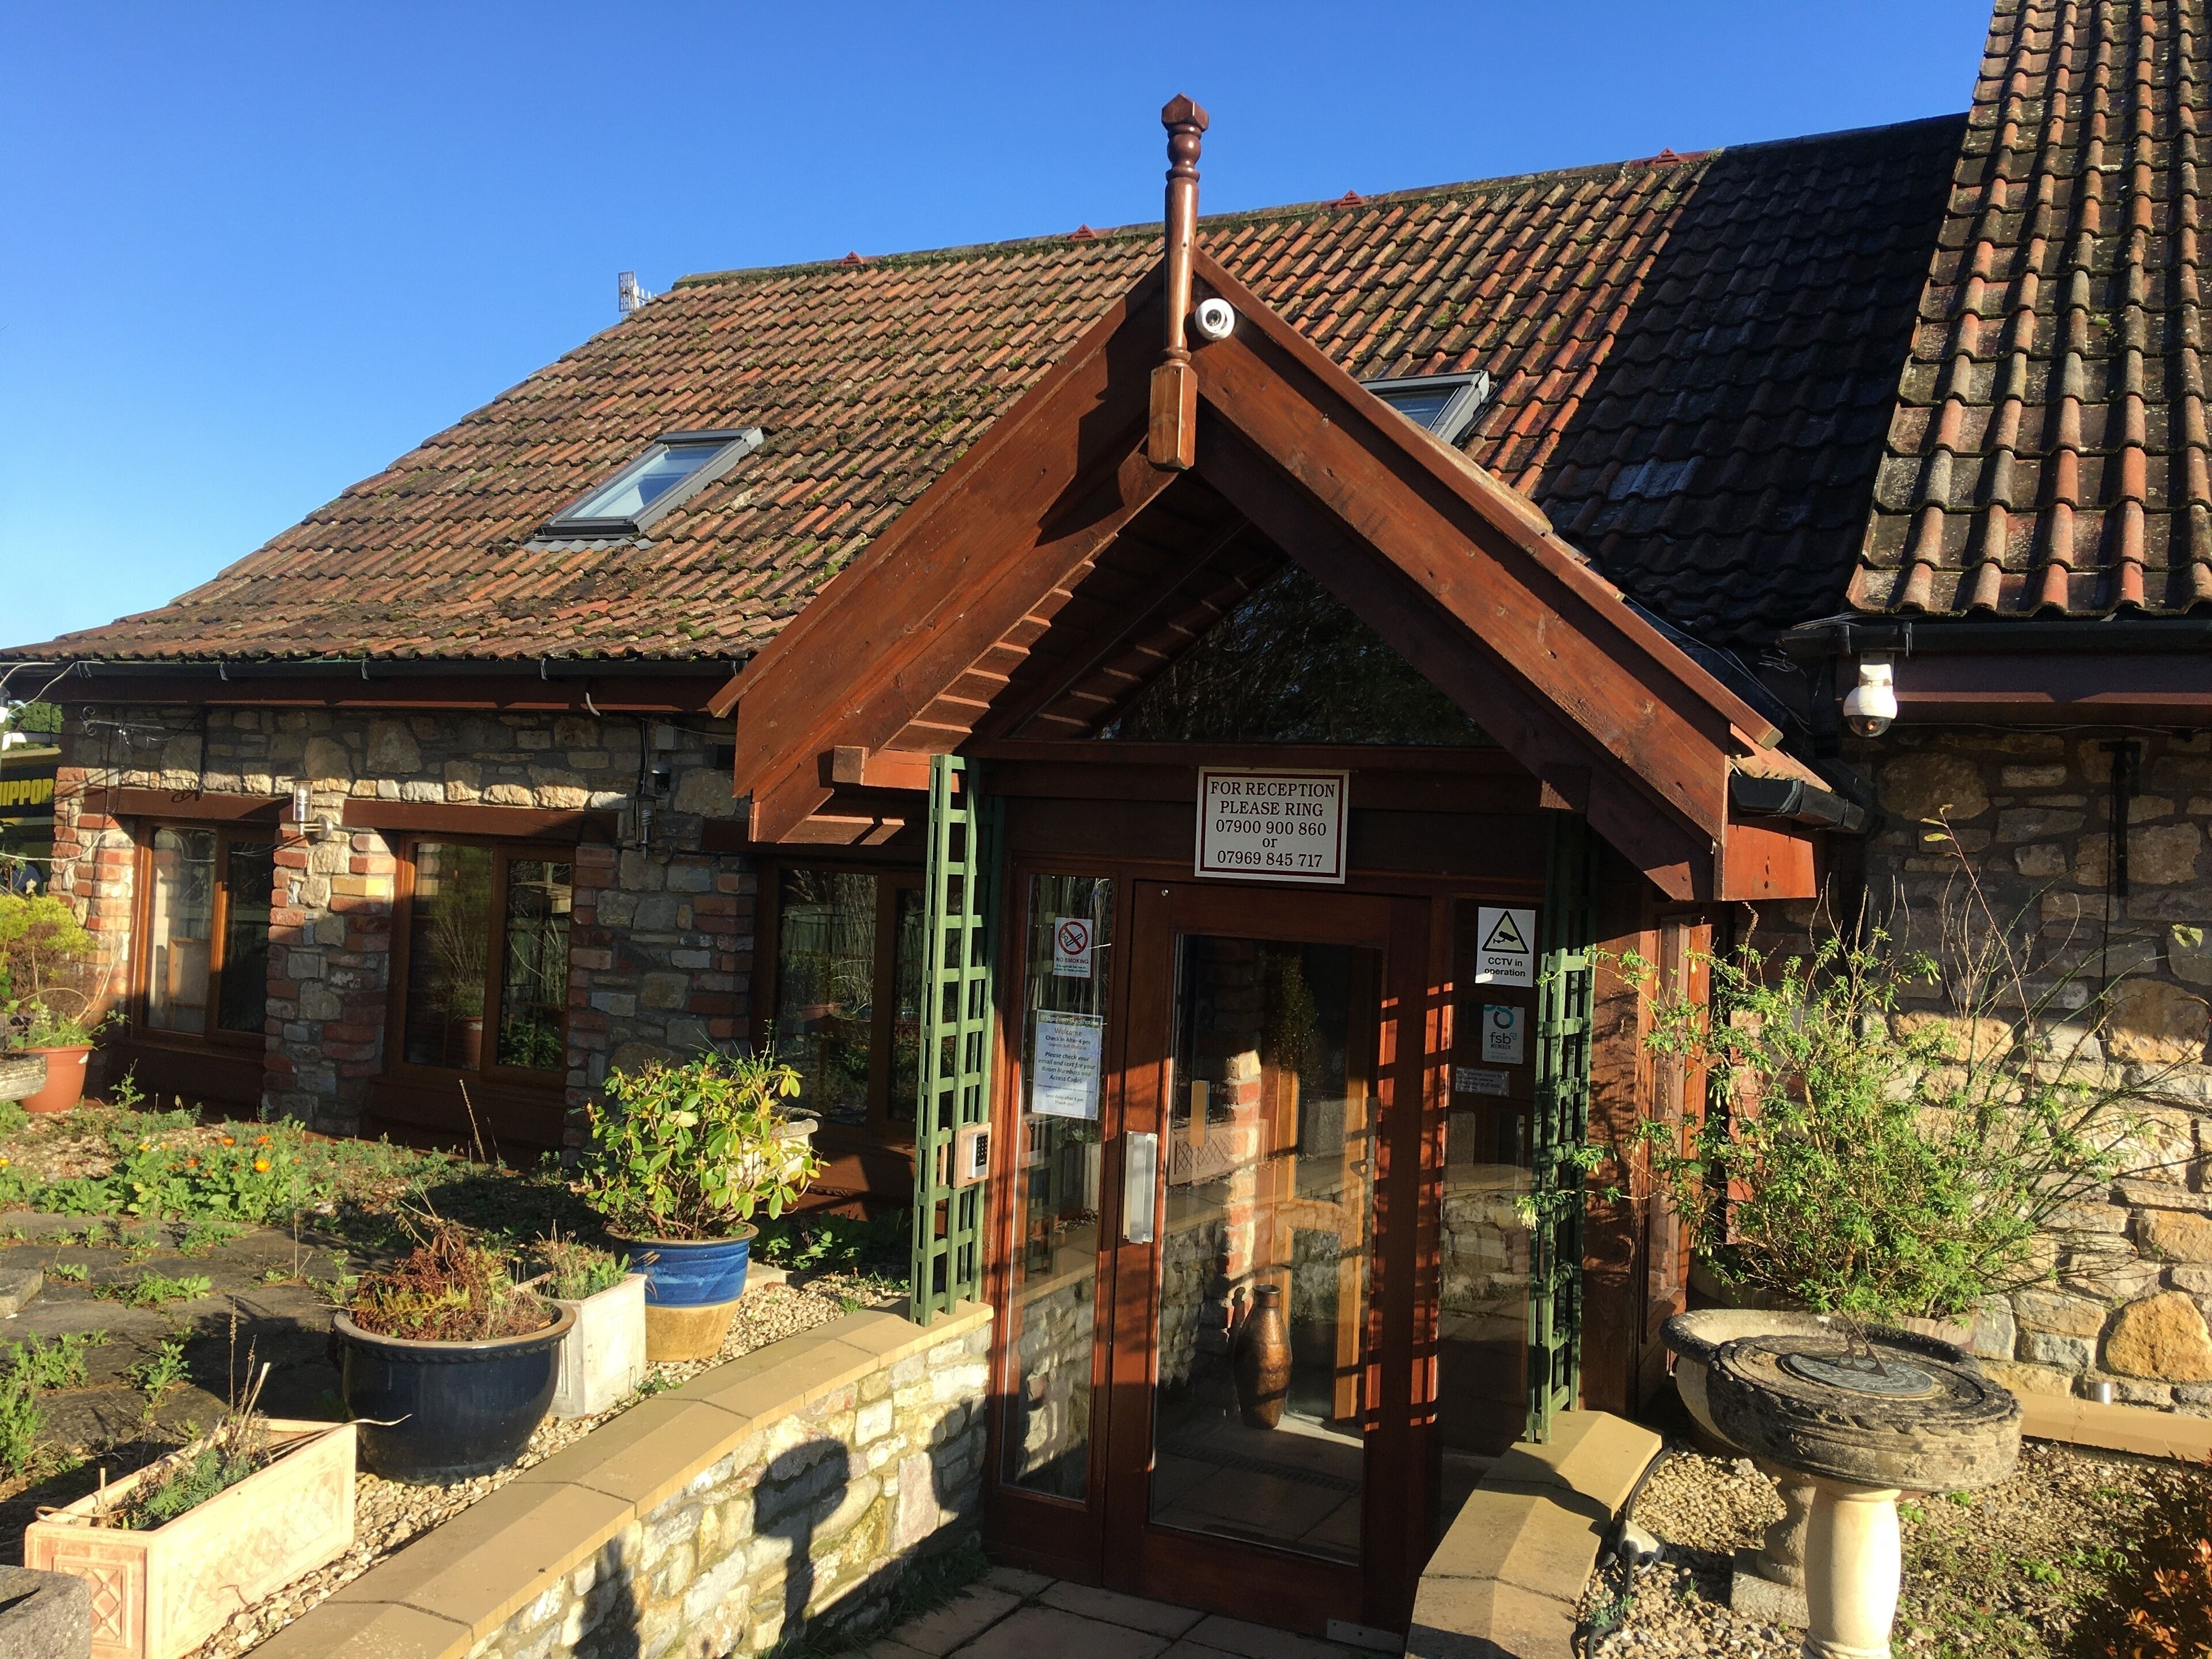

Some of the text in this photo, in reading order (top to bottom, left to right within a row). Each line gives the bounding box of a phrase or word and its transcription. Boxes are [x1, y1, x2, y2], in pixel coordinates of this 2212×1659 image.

[1210, 781, 1335, 798] FOR RECEPTION
[1220, 801, 1324, 817] PLEASE RING
[1215, 819, 1327, 836] 07900 900 860
[1262, 838, 1277, 848] or
[1217, 850, 1323, 868] 07969 845 717
[1488, 957, 1513, 966] CCTV
[1484, 968, 1526, 977] operation
[1054, 1027, 1082, 1036] Welcome
[1490, 1032, 1511, 1044] fsb
